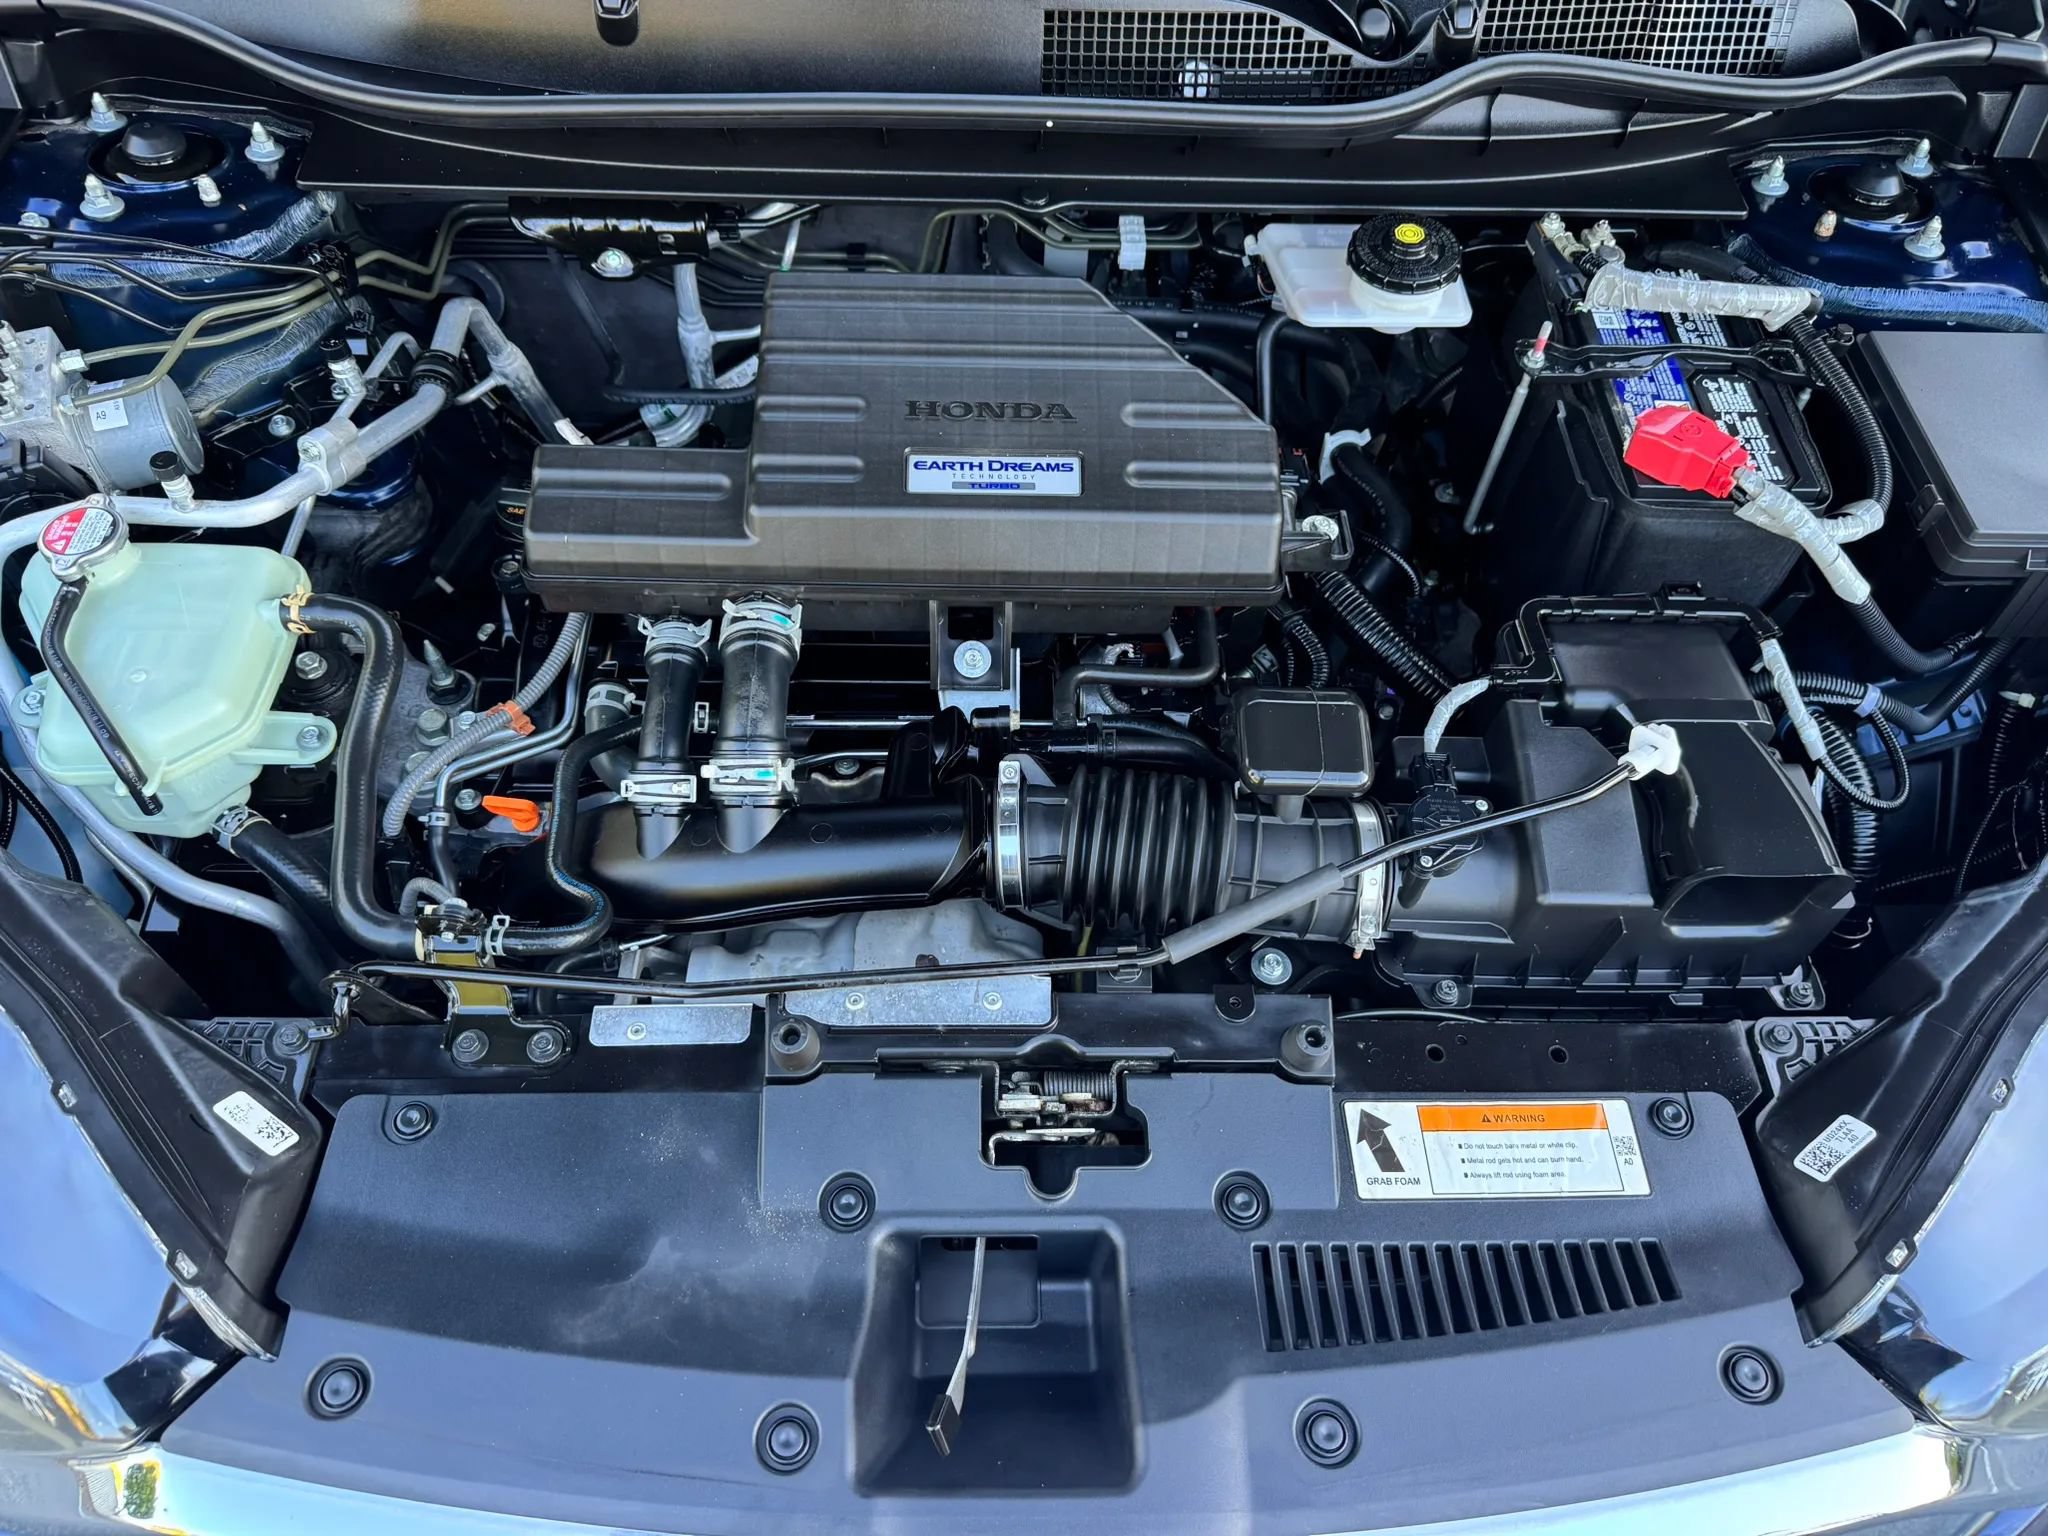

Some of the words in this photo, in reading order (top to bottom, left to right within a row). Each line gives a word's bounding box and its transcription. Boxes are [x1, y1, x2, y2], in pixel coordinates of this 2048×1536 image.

[903, 399, 1079, 423] HONDA
[913, 460, 983, 471] EARTH
[987, 460, 1074, 473] DREAMS
[1493, 1113, 1545, 1123] WARNING
[1497, 1157, 1511, 1165] gets
[1470, 1171, 1493, 1180] Always
[1515, 1171, 1532, 1179] using
[1366, 1177, 1393, 1187] GRAB
[1394, 1177, 1421, 1186] FOAM
